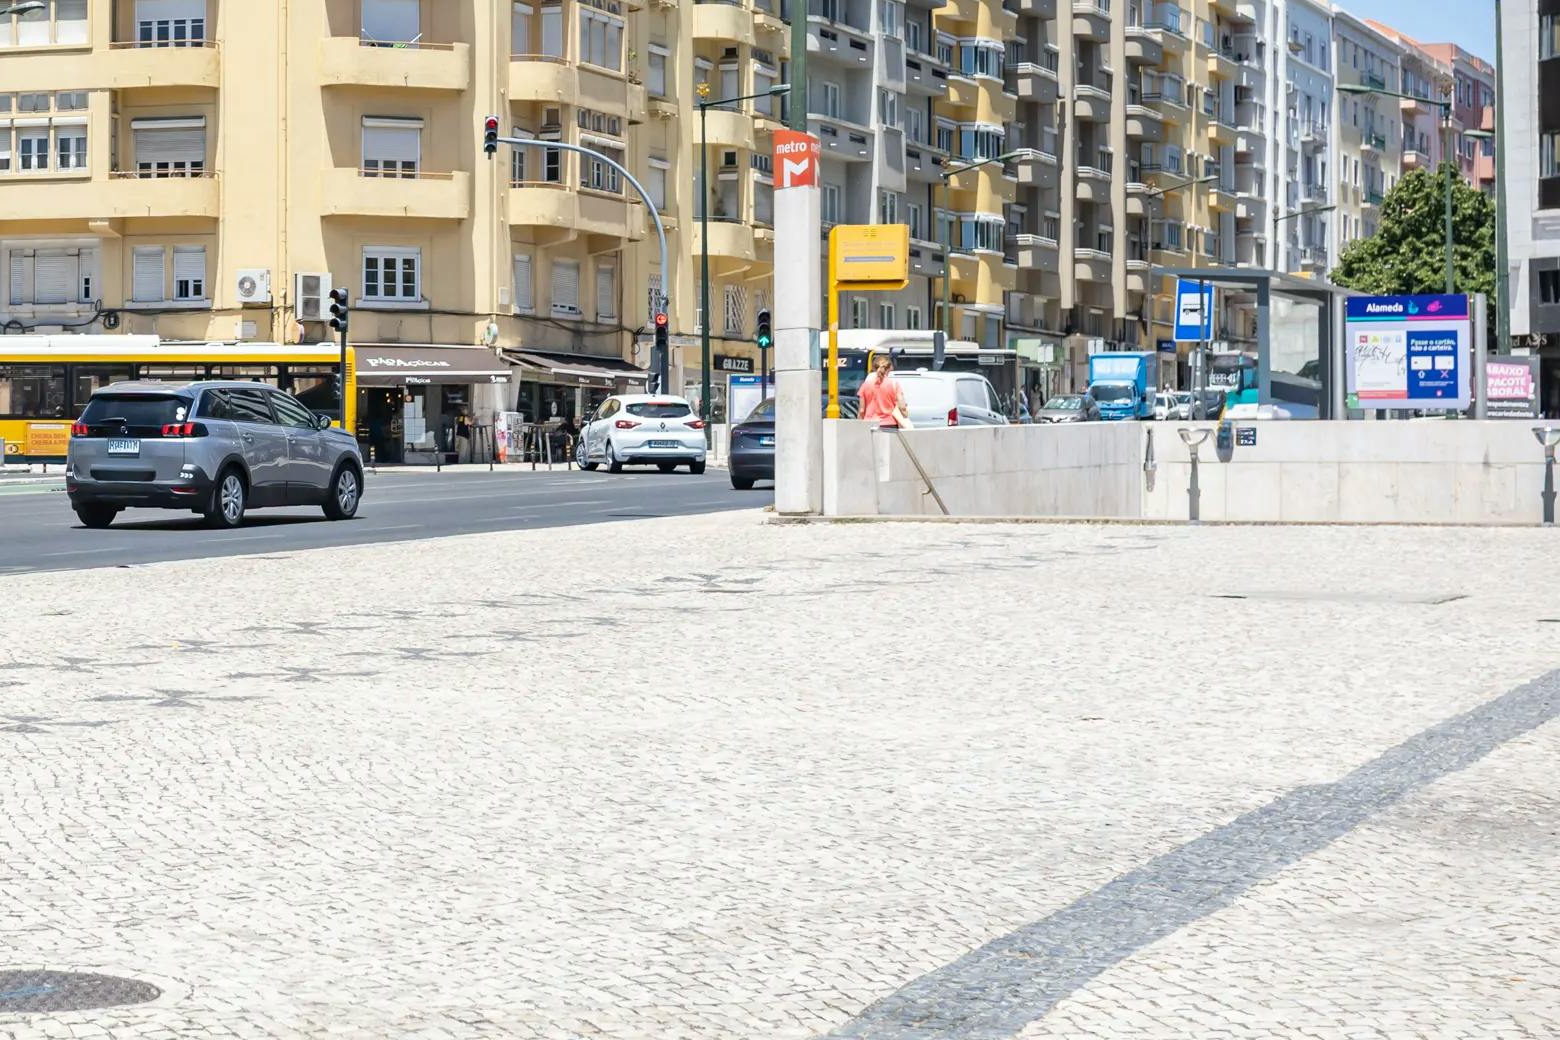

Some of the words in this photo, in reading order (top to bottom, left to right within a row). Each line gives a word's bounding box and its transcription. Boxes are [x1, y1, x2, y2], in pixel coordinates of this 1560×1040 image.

[776, 141, 807, 154] metro
[1366, 303, 1404, 313] Alameda
[723, 359, 748, 370] GRAZZE
[1487, 387, 1527, 396] ABORAL
